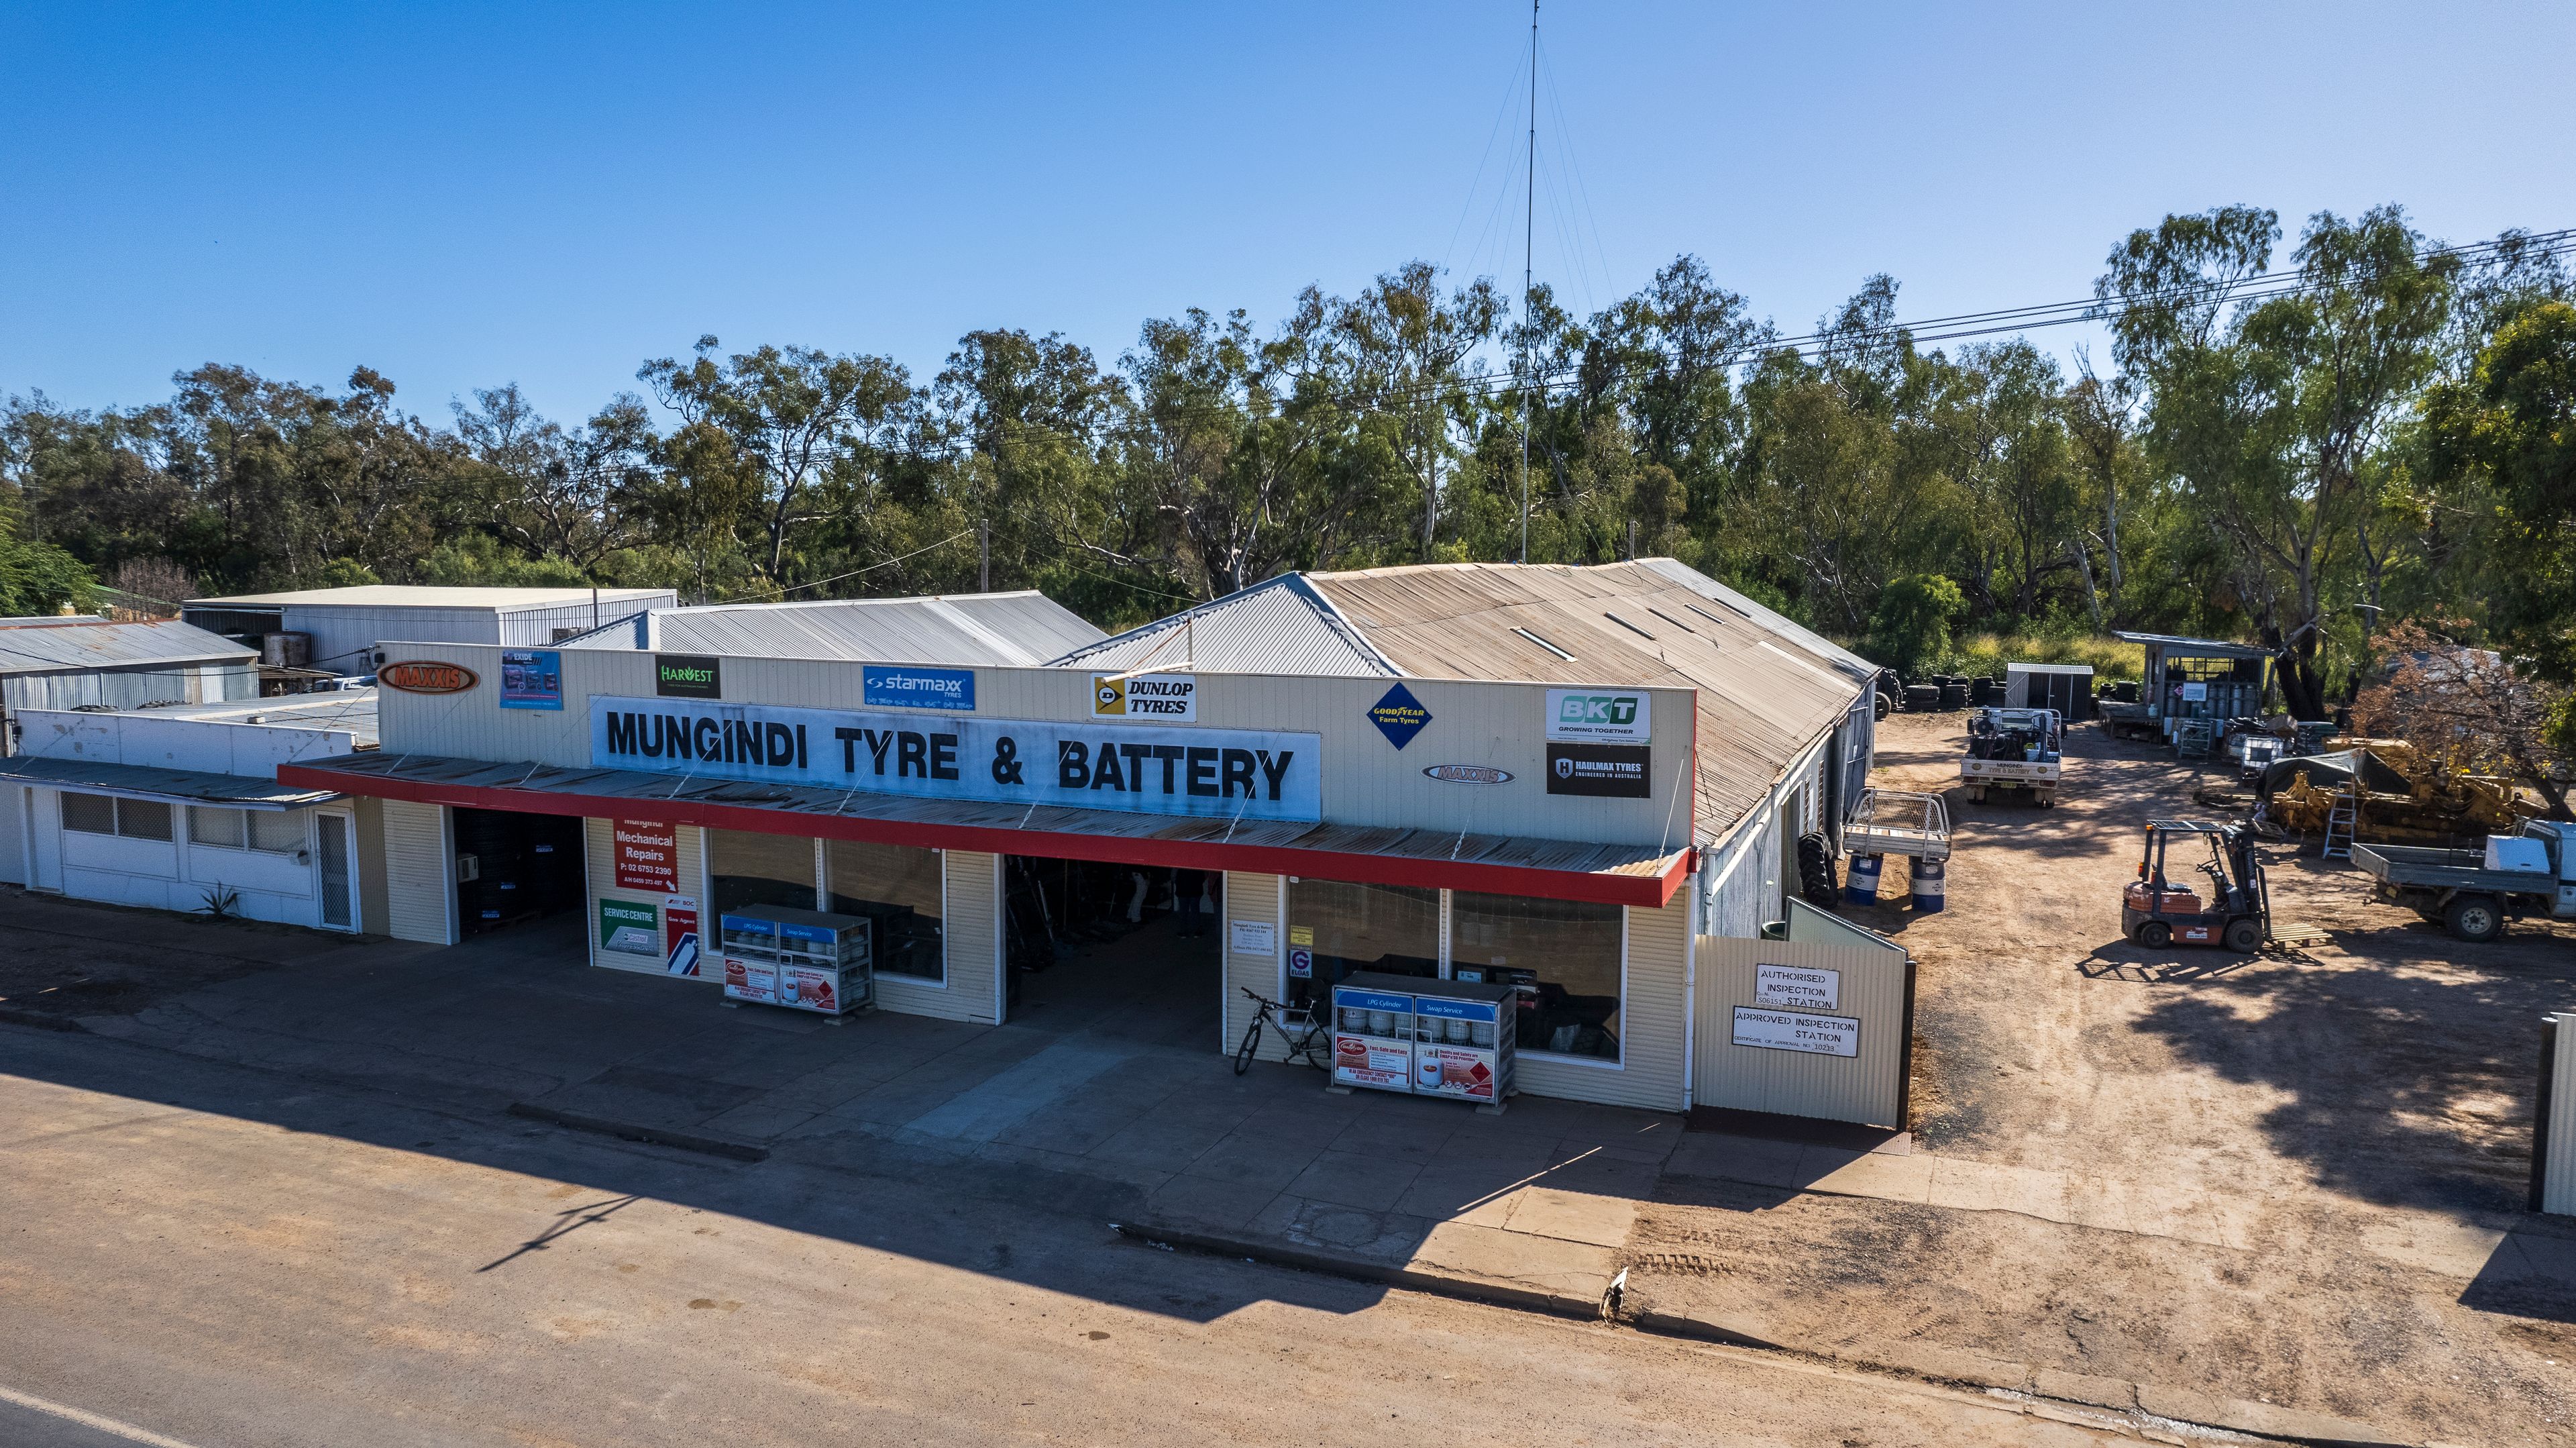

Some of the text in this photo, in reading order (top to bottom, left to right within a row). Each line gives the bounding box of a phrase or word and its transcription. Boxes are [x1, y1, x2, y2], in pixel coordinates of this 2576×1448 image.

[394, 666, 461, 689] MAXXIS
[661, 665, 713, 682] HARVEST
[885, 674, 963, 692] starmaxx
[1128, 681, 1193, 696] DUNLOP
[1131, 699, 1187, 715] TYRES
[1562, 699, 1635, 721] BKT
[606, 711, 1295, 801] MUNGINDI TYRE & BATTERY
[1437, 767, 1500, 783] MAXXIS
[1560, 761, 1642, 774] H HAULMAX TYRES
[616, 830, 673, 847] Mechanical
[626, 847, 664, 862] Repairs
[628, 864, 637, 872] 02
[637, 865, 653, 873] 6753
[655, 866, 672, 876] 2390
[604, 907, 653, 922] SERVICE CENTRE
[629, 933, 647, 943] Castrol
[1760, 970, 1826, 984] AUTHORISED
[1767, 984, 1826, 997] INSPECTION
[1379, 1000, 1402, 1008] Cylinder
[1758, 997, 1782, 1005] S06151
[1787, 997, 1832, 1009] STATION
[1426, 1004, 1463, 1015] Swap Service
[1735, 1012, 1855, 1032] APPROVED INSPECTION
[1734, 1035, 1762, 1043] CERTIFICATE
[1814, 1043, 1835, 1051] 10213
[1795, 1030, 1841, 1043] STATION
